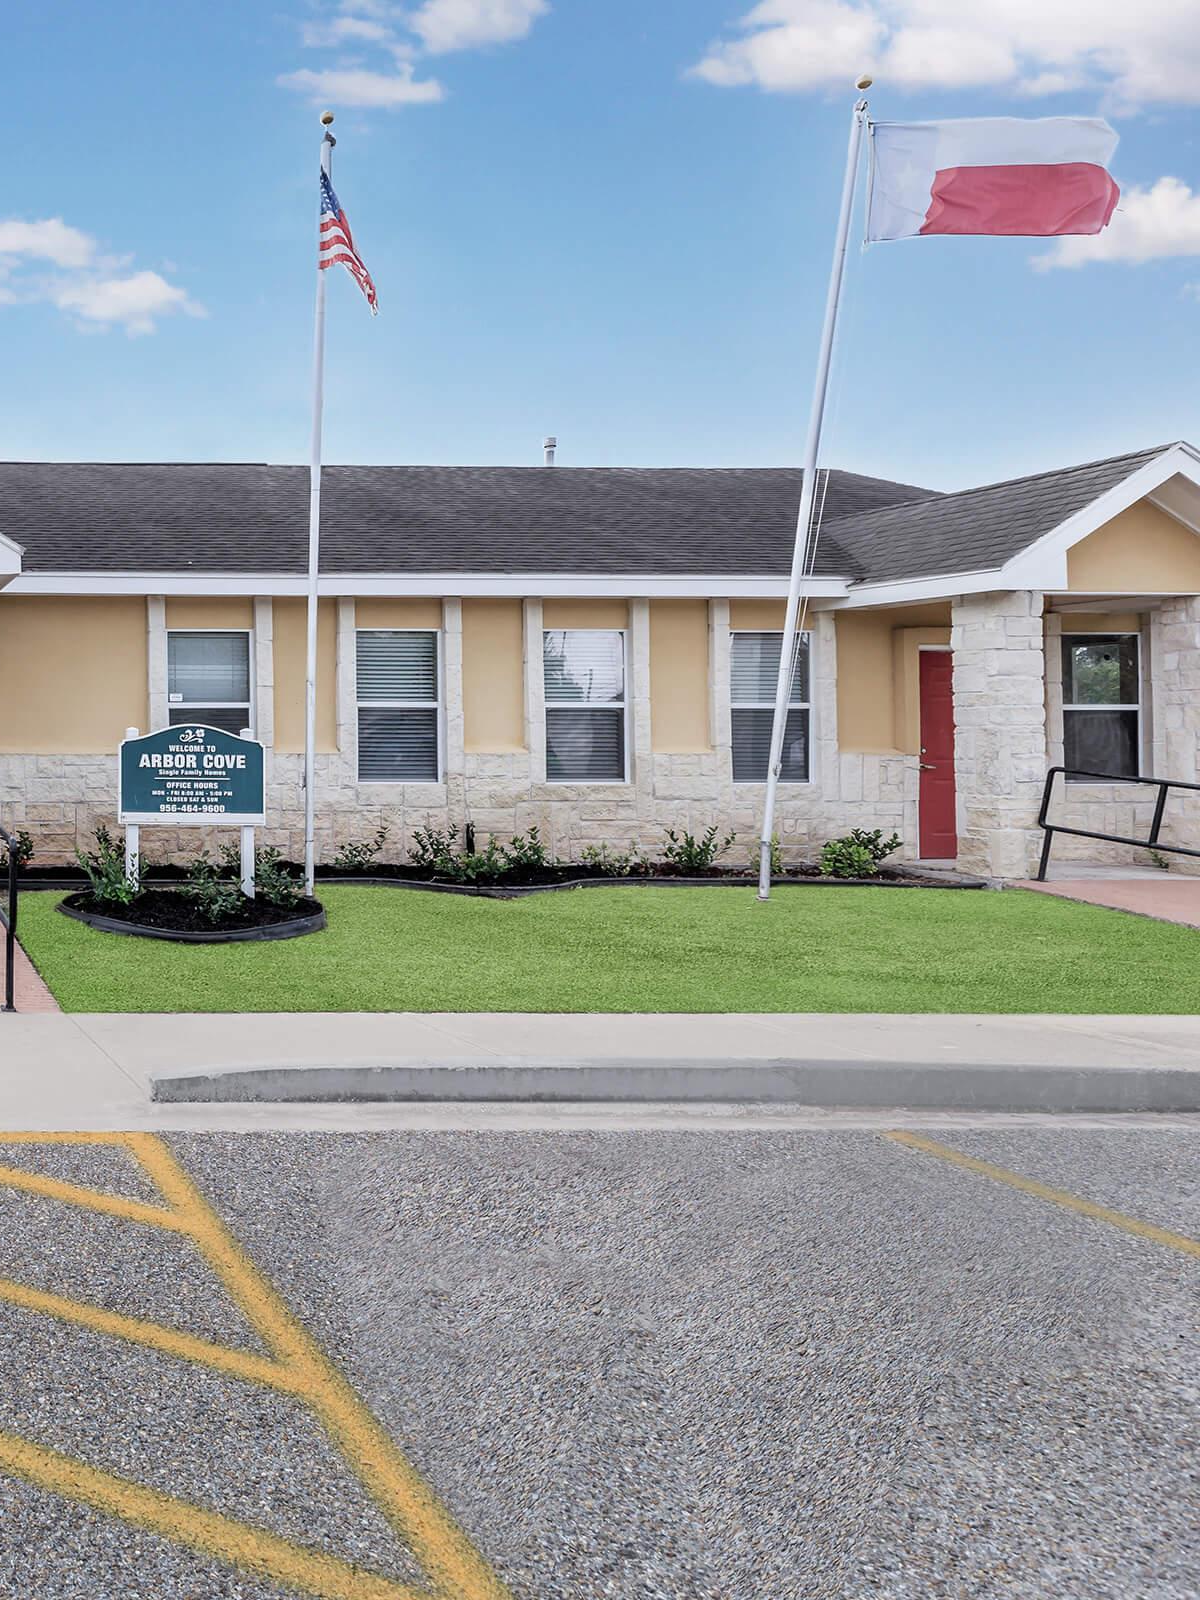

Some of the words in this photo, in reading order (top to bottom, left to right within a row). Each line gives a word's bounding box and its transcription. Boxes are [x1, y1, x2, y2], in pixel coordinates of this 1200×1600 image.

[138, 754, 197, 768] ARBOR
[203, 754, 246, 768] COVE
[160, 804, 226, 813] 956-464-9600
